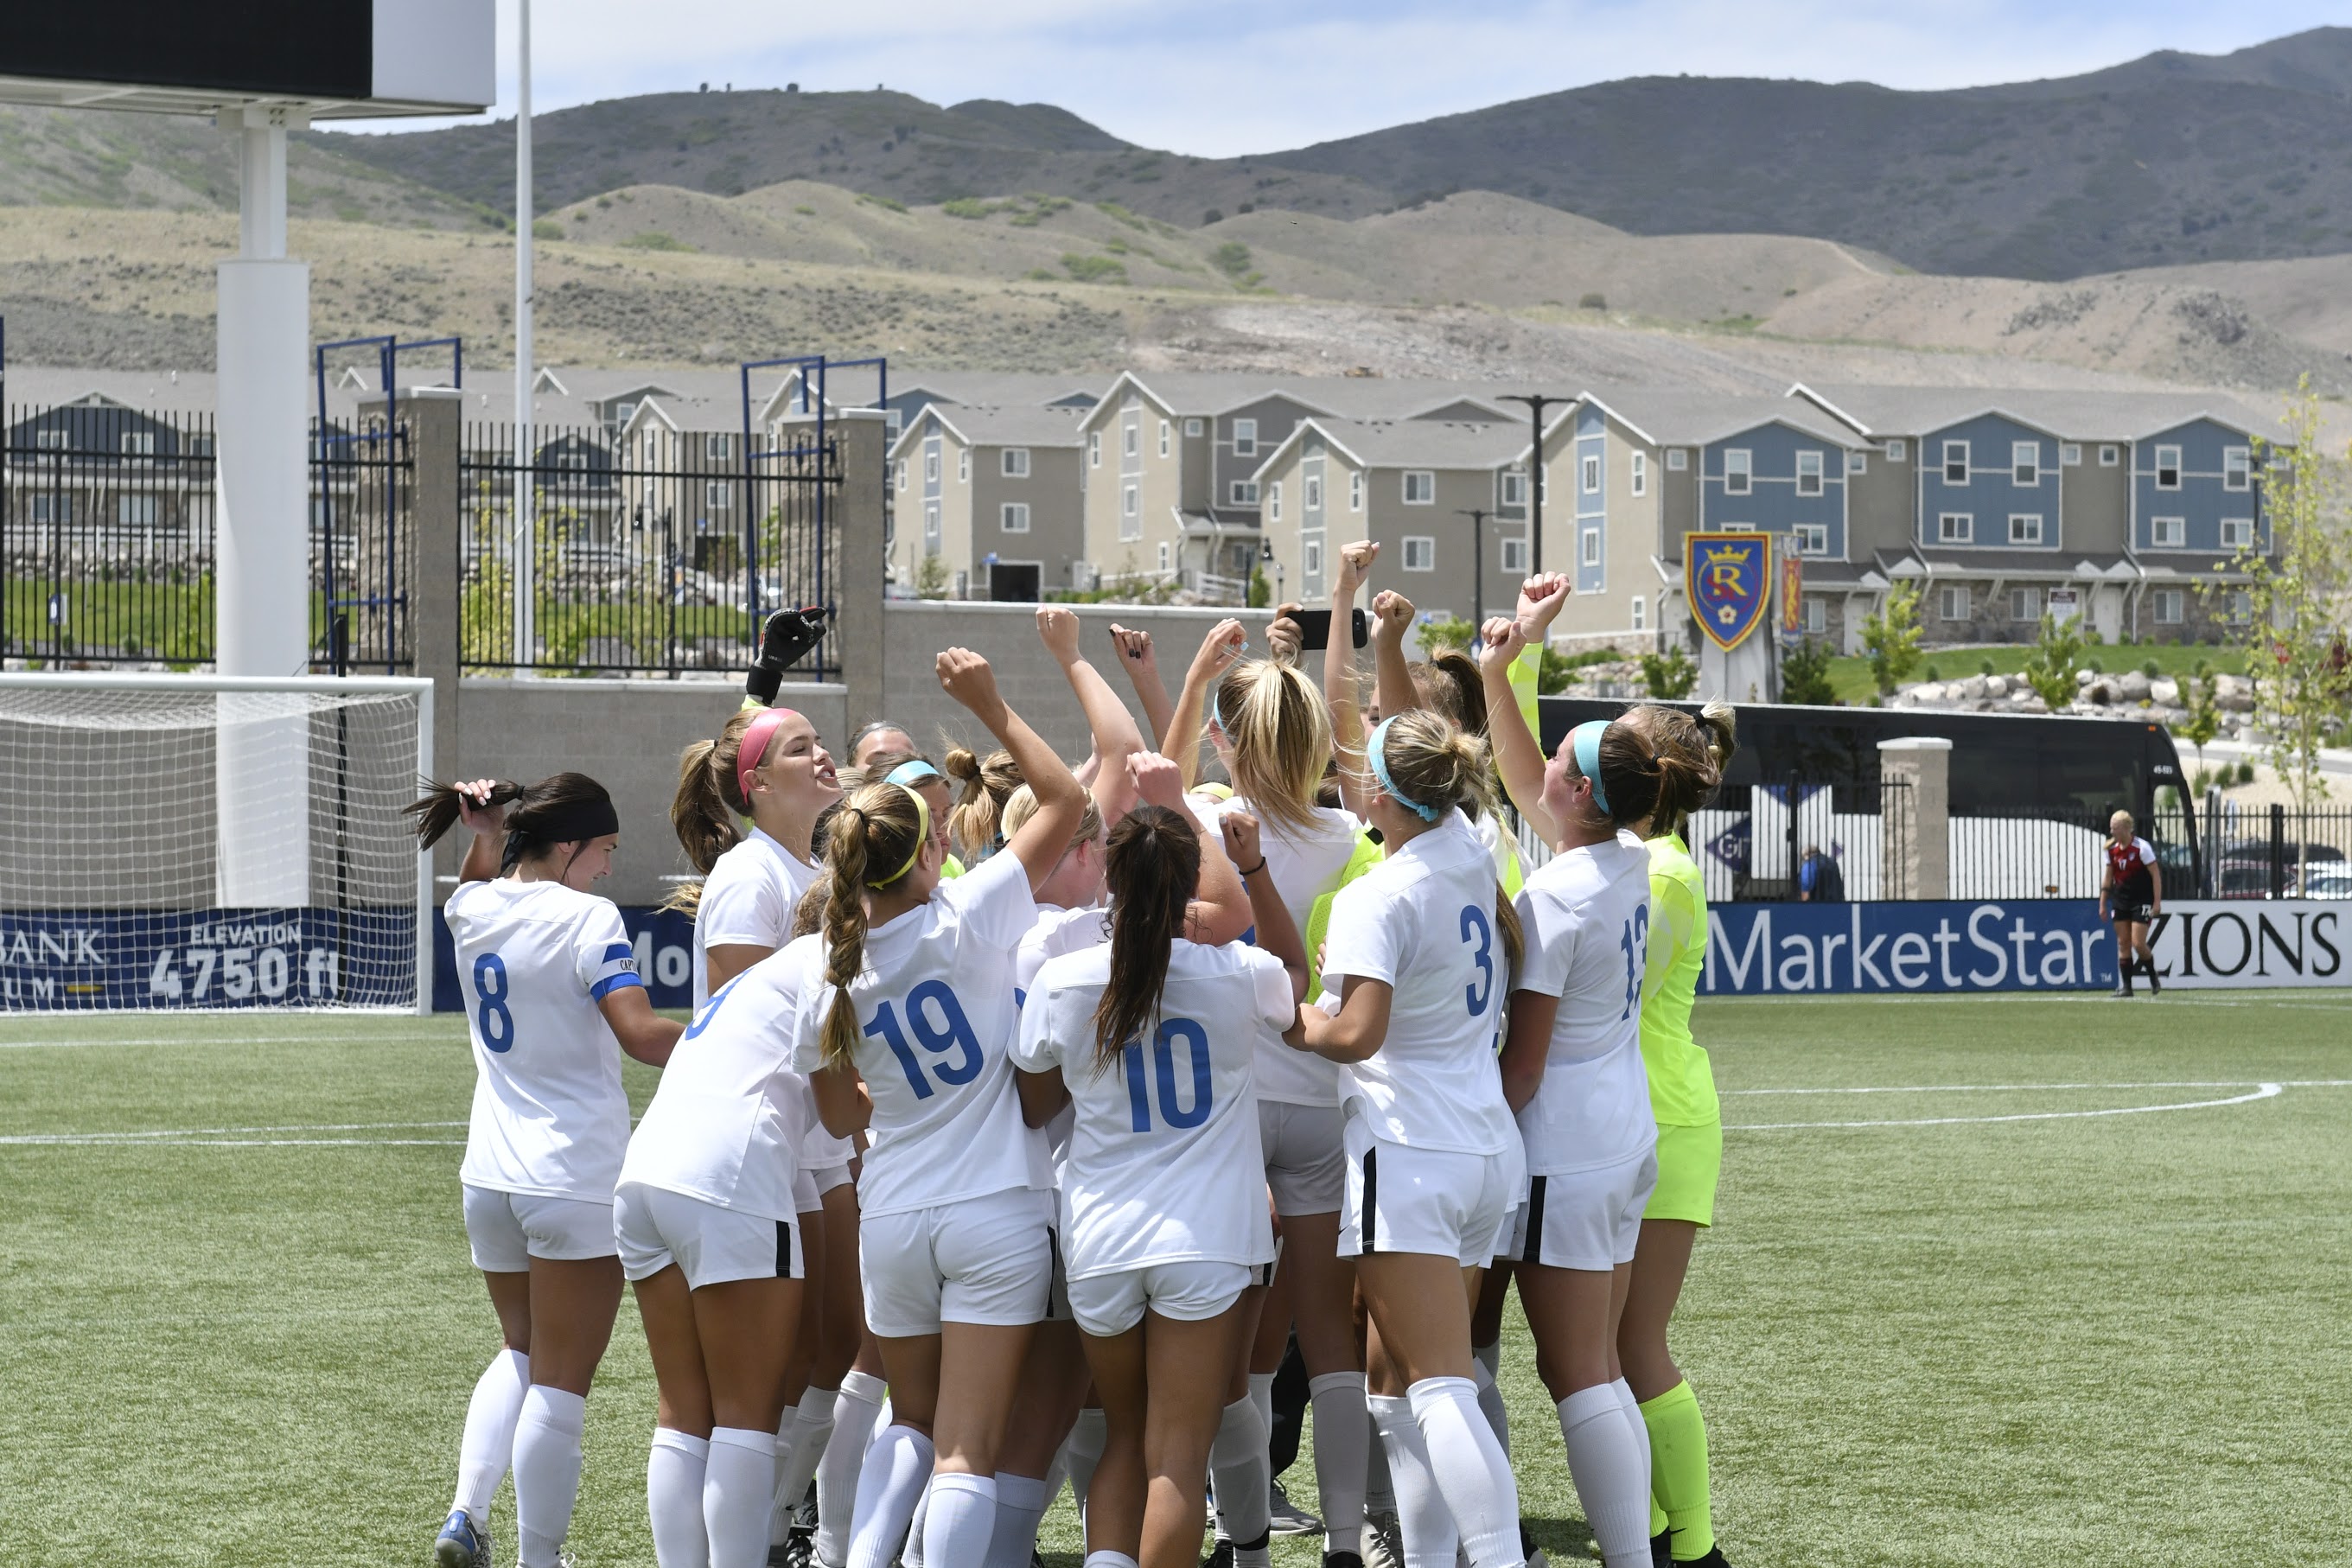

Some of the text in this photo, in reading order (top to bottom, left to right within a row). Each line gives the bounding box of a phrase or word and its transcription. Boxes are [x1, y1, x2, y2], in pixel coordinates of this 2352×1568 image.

[150, 947, 289, 998] 4750
[190, 925, 301, 945] ELEVATION
[1460, 904, 1493, 1017] 3
[1706, 903, 2106, 991] MarketStar
[2132, 912, 2340, 978] ZIONS
[474, 953, 514, 1053] 8
[863, 979, 984, 1100] 19
[1106, 1017, 1212, 1133] 10
